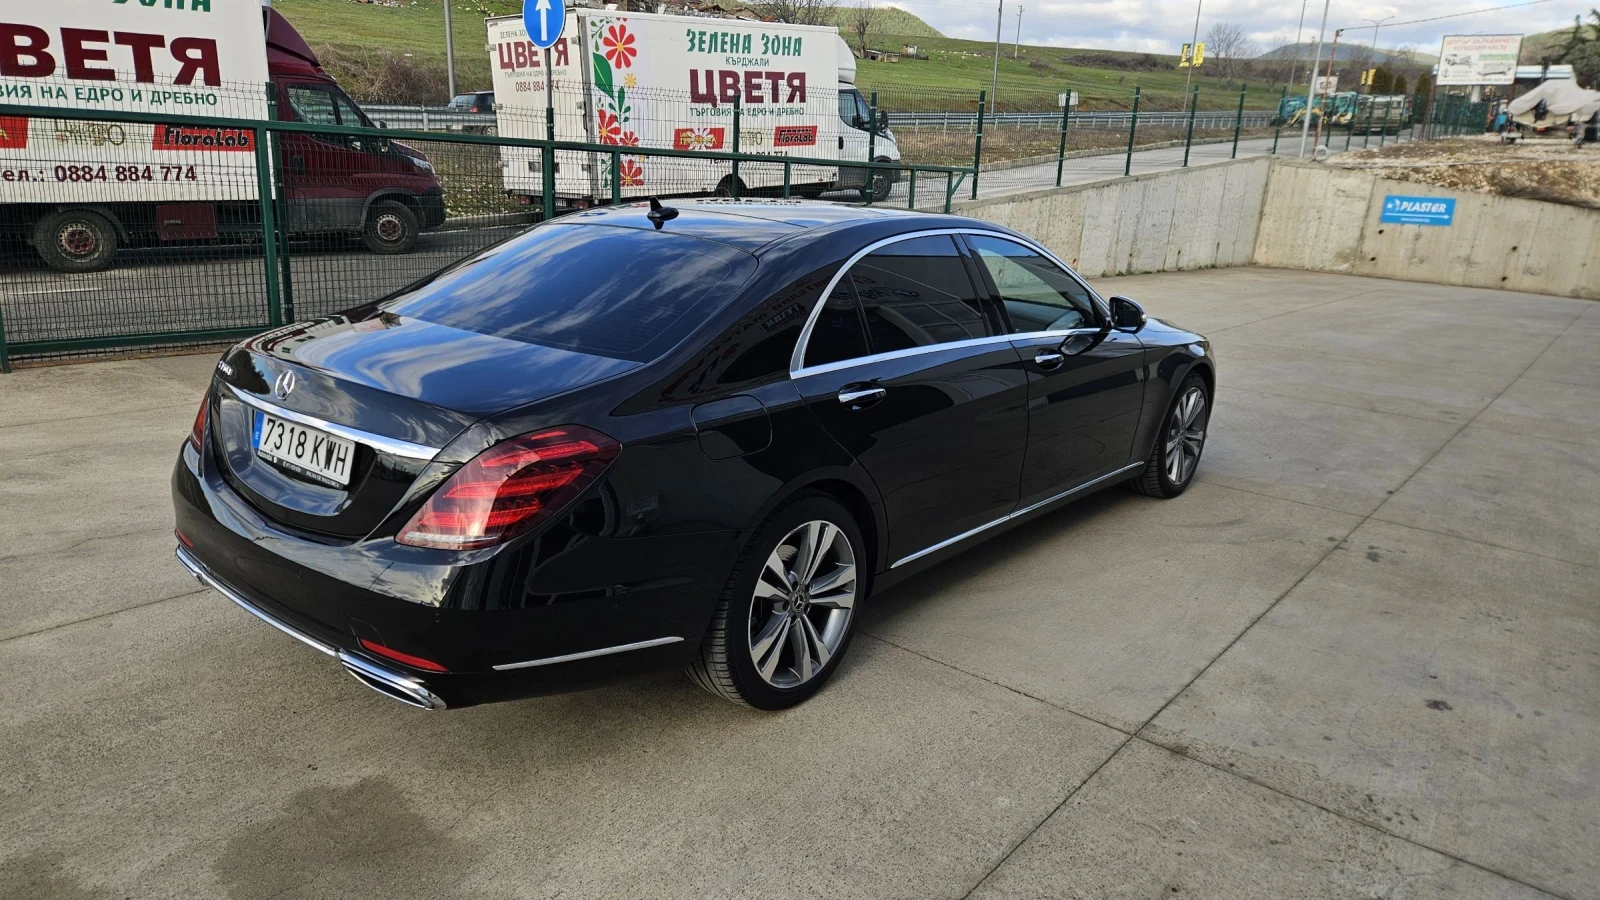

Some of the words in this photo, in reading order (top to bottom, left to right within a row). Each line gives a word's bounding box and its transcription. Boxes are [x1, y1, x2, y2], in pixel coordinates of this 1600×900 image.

[500, 30, 517, 39] ЗЕЛЕНА
[686, 28, 752, 54] ЗЕЛЕНА
[761, 33, 802, 56] ЗОНА
[725, 57, 769, 67] КЪРДЖАЛИ
[40, 85, 68, 100] НА
[75, 87, 124, 103] ЕДРО
[131, 89, 142, 102] И
[150, 91, 218, 106] ДРЕБНО
[690, 68, 806, 108] ЦВЕТЯ
[690, 107, 732, 117] ТЪРГОВИЯ
[748, 107, 767, 118] ЕДРО
[777, 107, 805, 117] ДРЕБНО
[0, 169, 45, 182] ел.:
[54, 165, 107, 182] 0884
[115, 165, 153, 182] 884
[160, 165, 197, 182] 774
[264, 417, 307, 459] 7318
[310, 435, 349, 476] KWH
